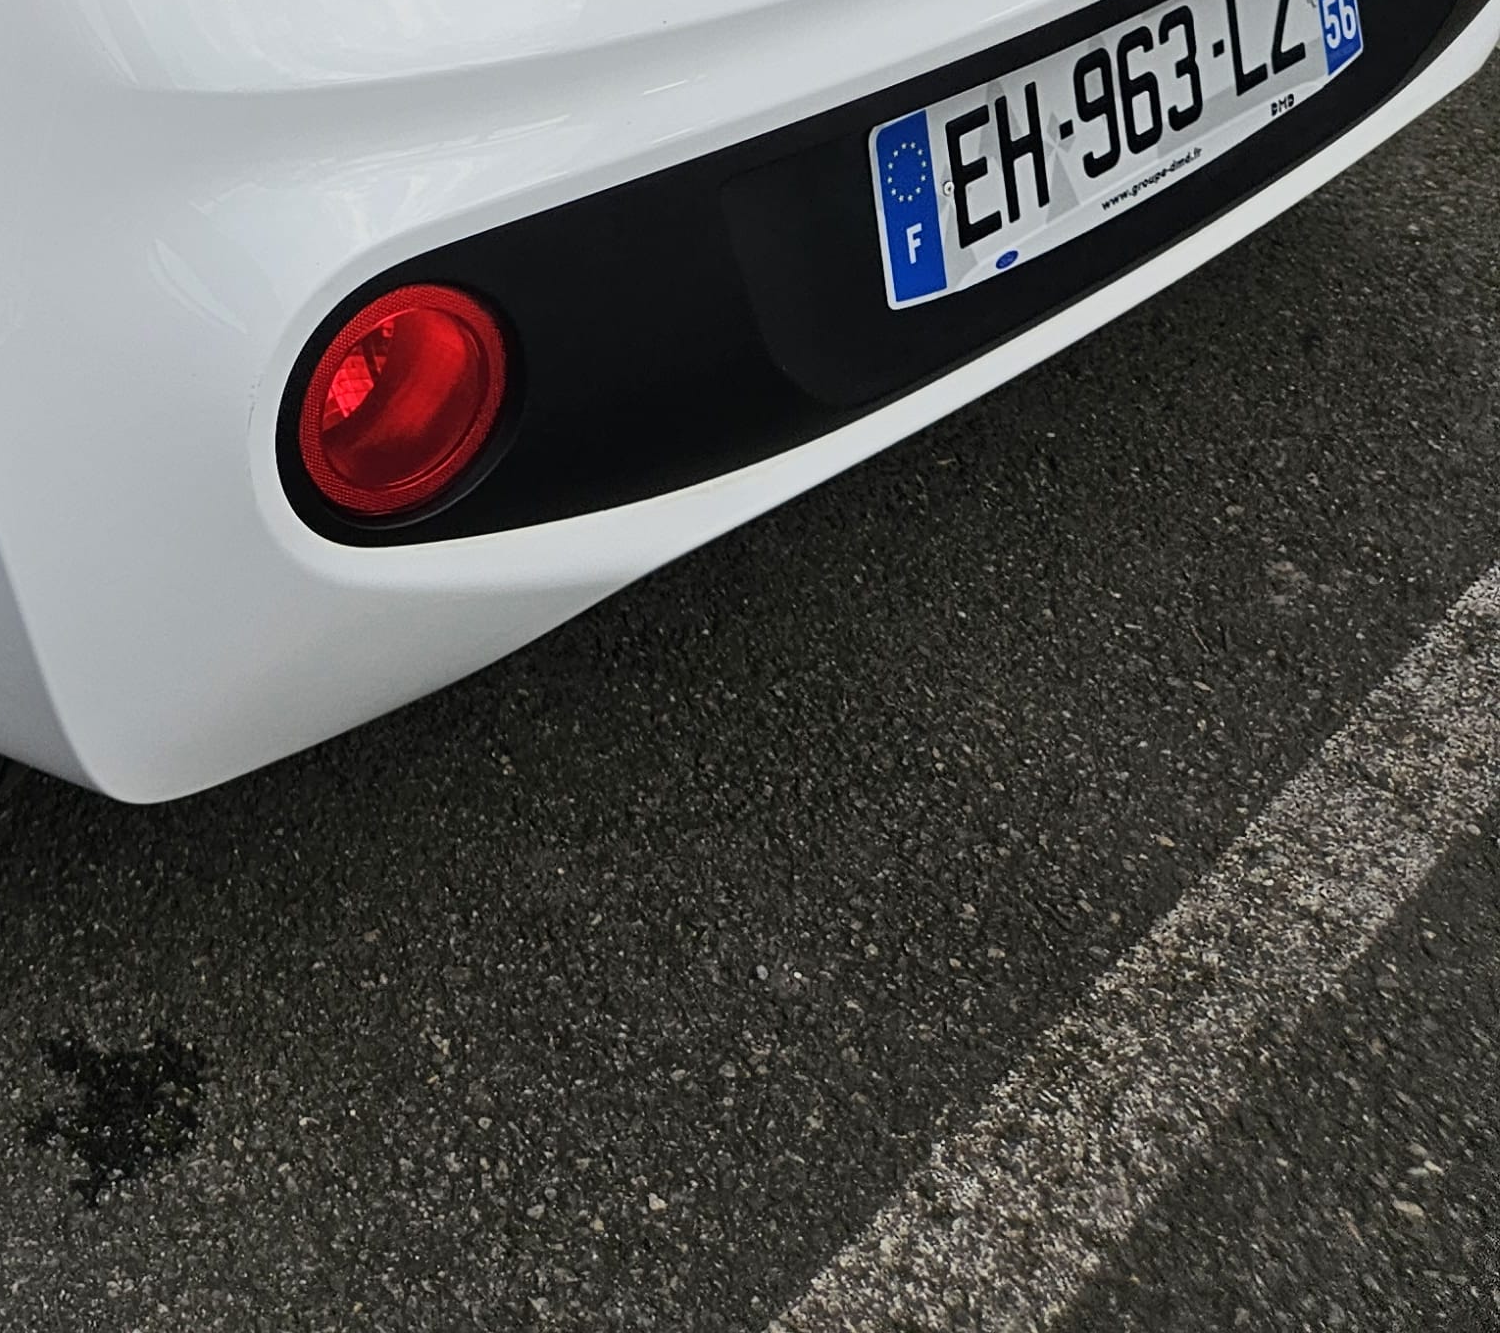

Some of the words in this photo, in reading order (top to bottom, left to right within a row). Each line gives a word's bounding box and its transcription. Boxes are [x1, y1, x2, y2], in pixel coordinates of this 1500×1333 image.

[1271, 93, 1295, 117] DMD
[1101, 147, 1202, 211] www.groupe-dmd.fr
[905, 222, 923, 265] F
